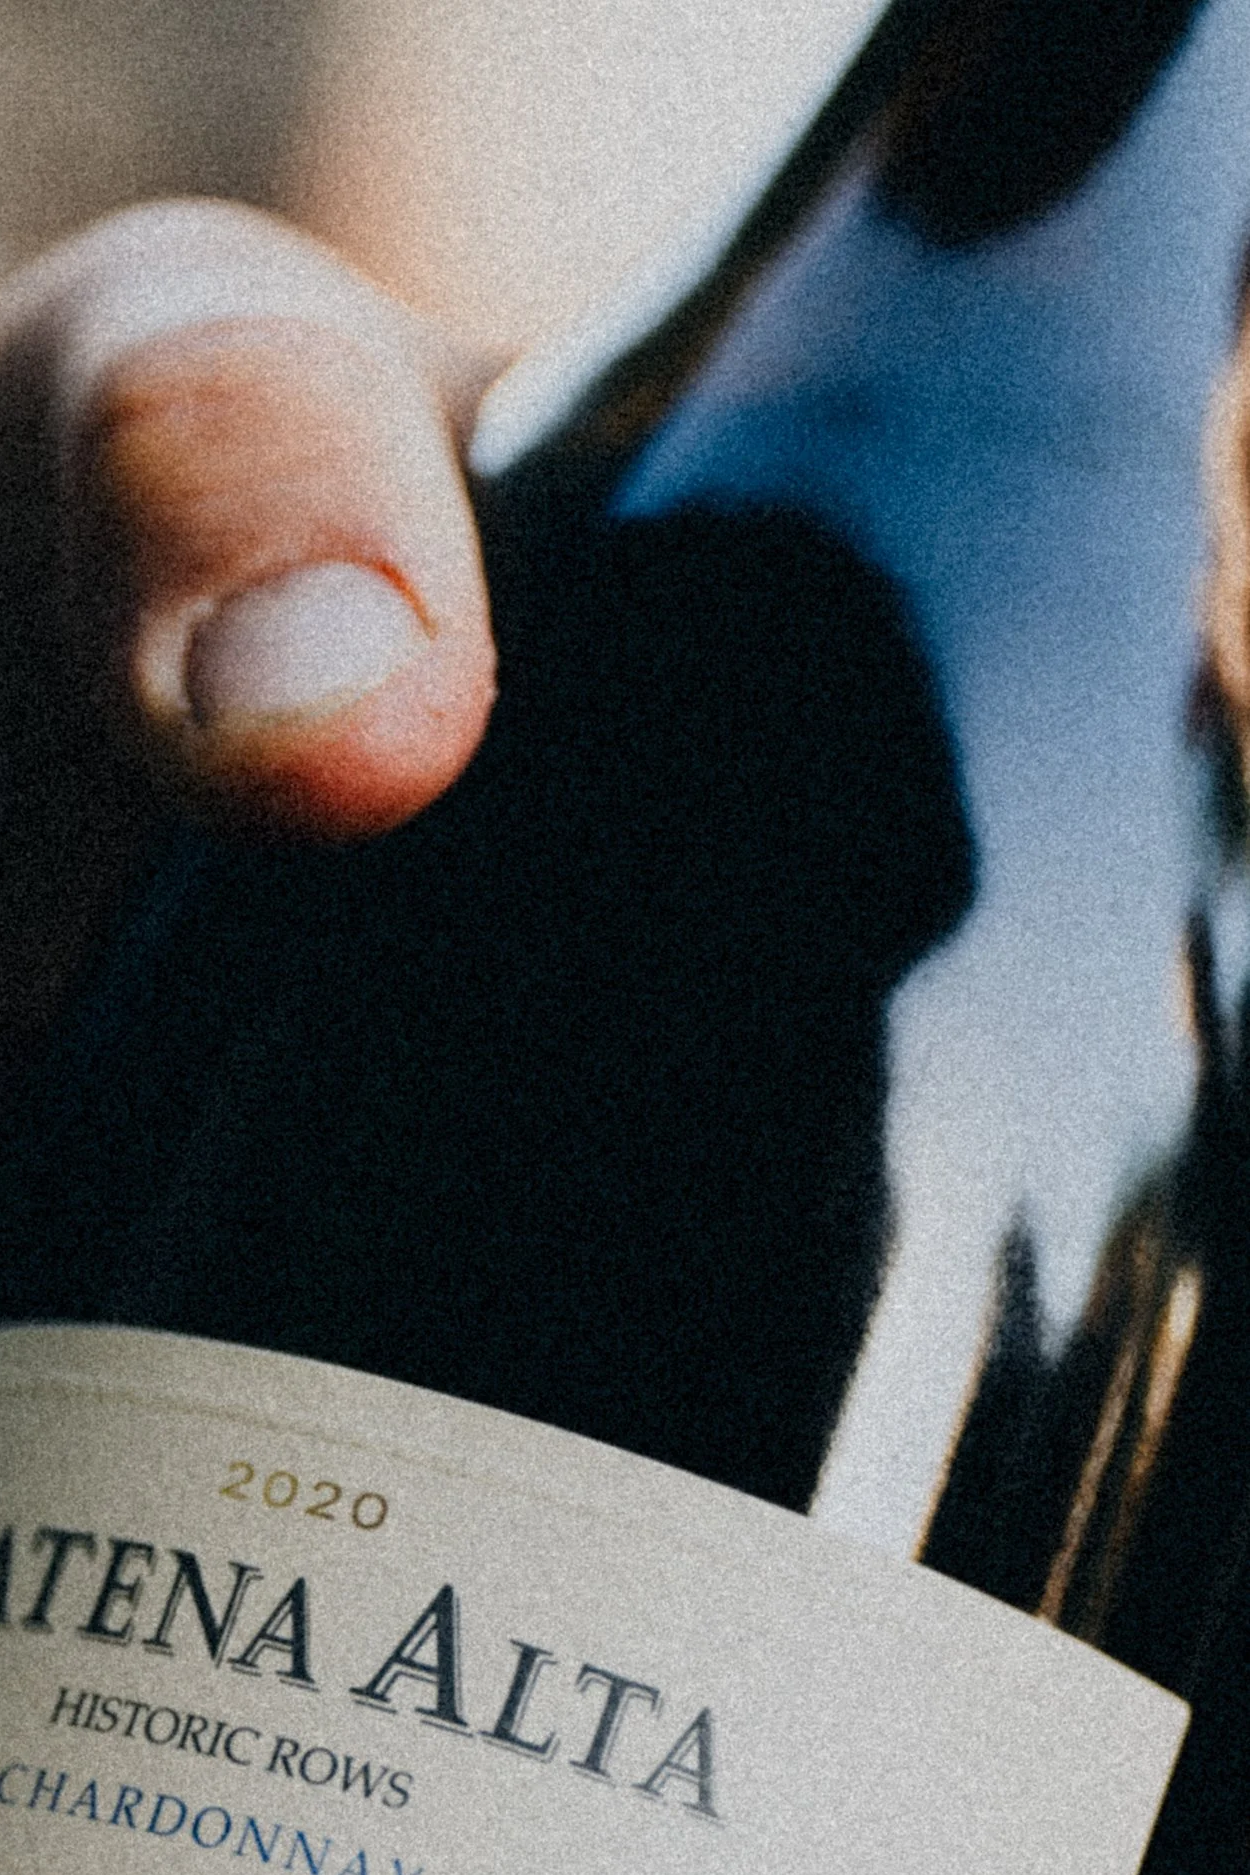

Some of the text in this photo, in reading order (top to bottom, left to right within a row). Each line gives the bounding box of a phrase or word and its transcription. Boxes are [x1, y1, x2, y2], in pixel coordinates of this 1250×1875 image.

[218, 1460, 391, 1531] 2020
[48, 1686, 415, 1810] HISTORIC ROWS
[350, 1581, 726, 1823] ALTA
